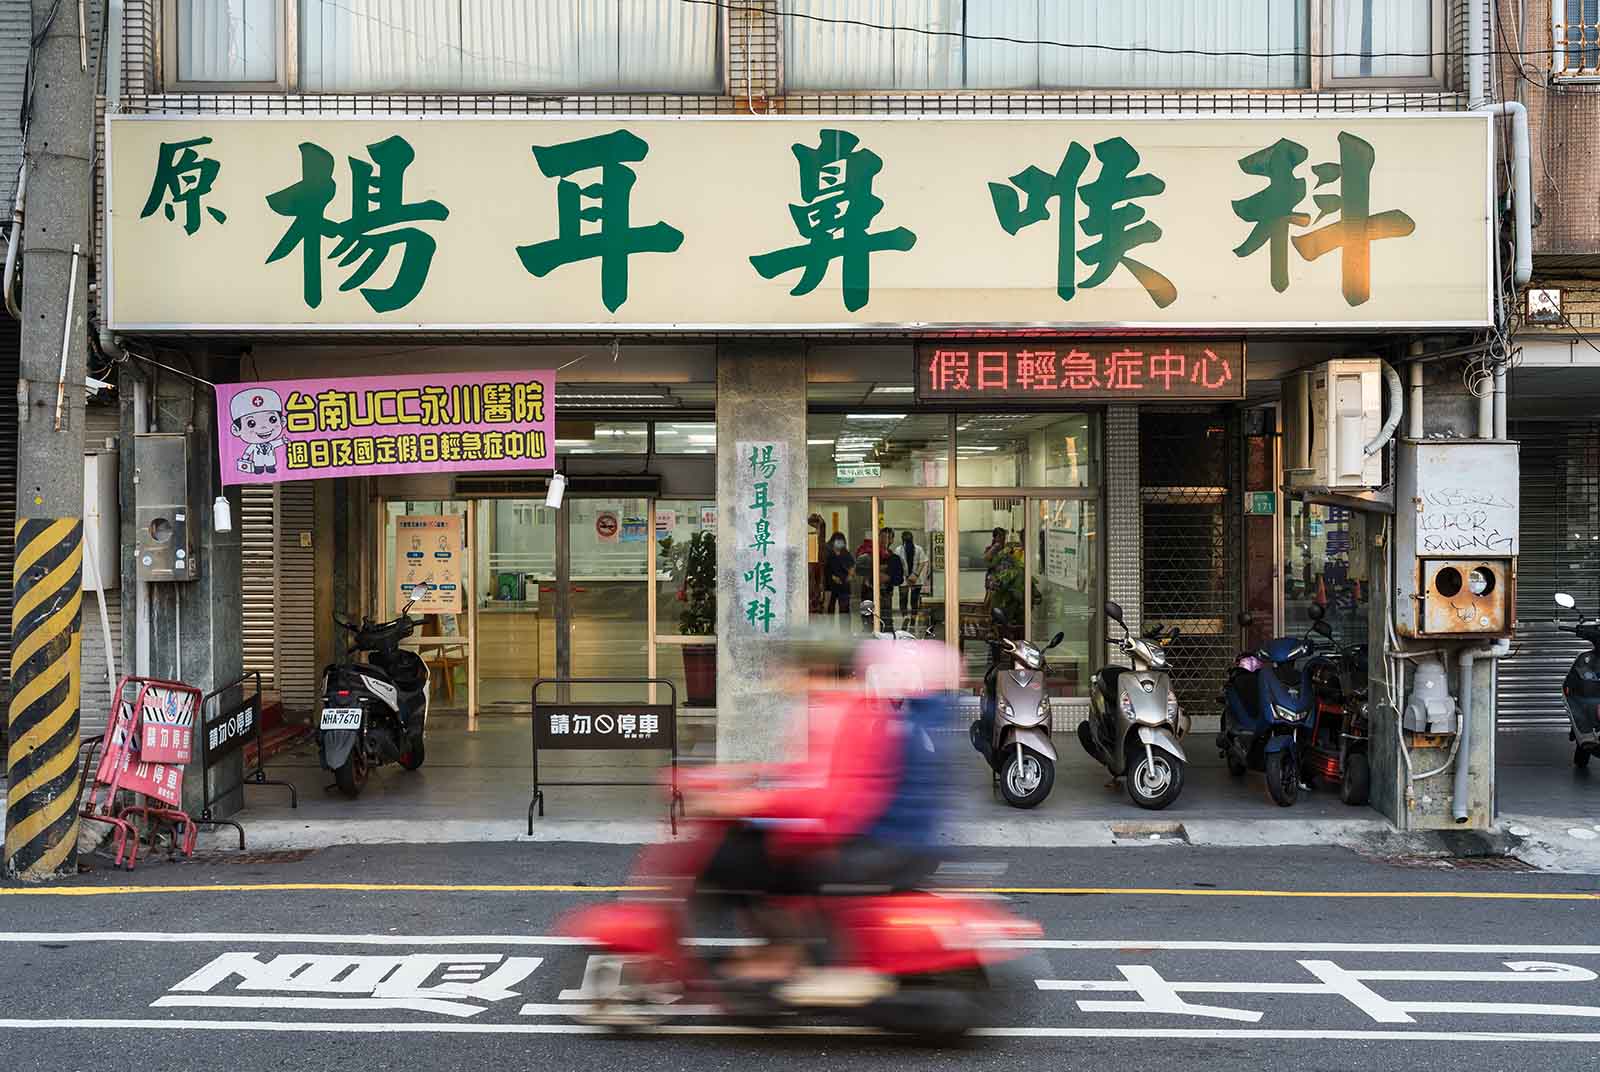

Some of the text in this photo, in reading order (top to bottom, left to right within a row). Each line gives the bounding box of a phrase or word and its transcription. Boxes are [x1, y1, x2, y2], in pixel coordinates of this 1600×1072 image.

[140, 129, 1416, 312] 原 楊耳鼻喉科
[929, 348, 1233, 390] 假日輕急症中心
[286, 380, 545, 432] 台南UCC永川醫院
[286, 429, 546, 469] 週日及國定假日輕急症中心
[744, 444, 778, 633] 楊耳鼻喉科
[209, 706, 253, 750] 請勿停車
[321, 713, 360, 725] NHA-7670
[550, 714, 659, 734] 請勿停車
